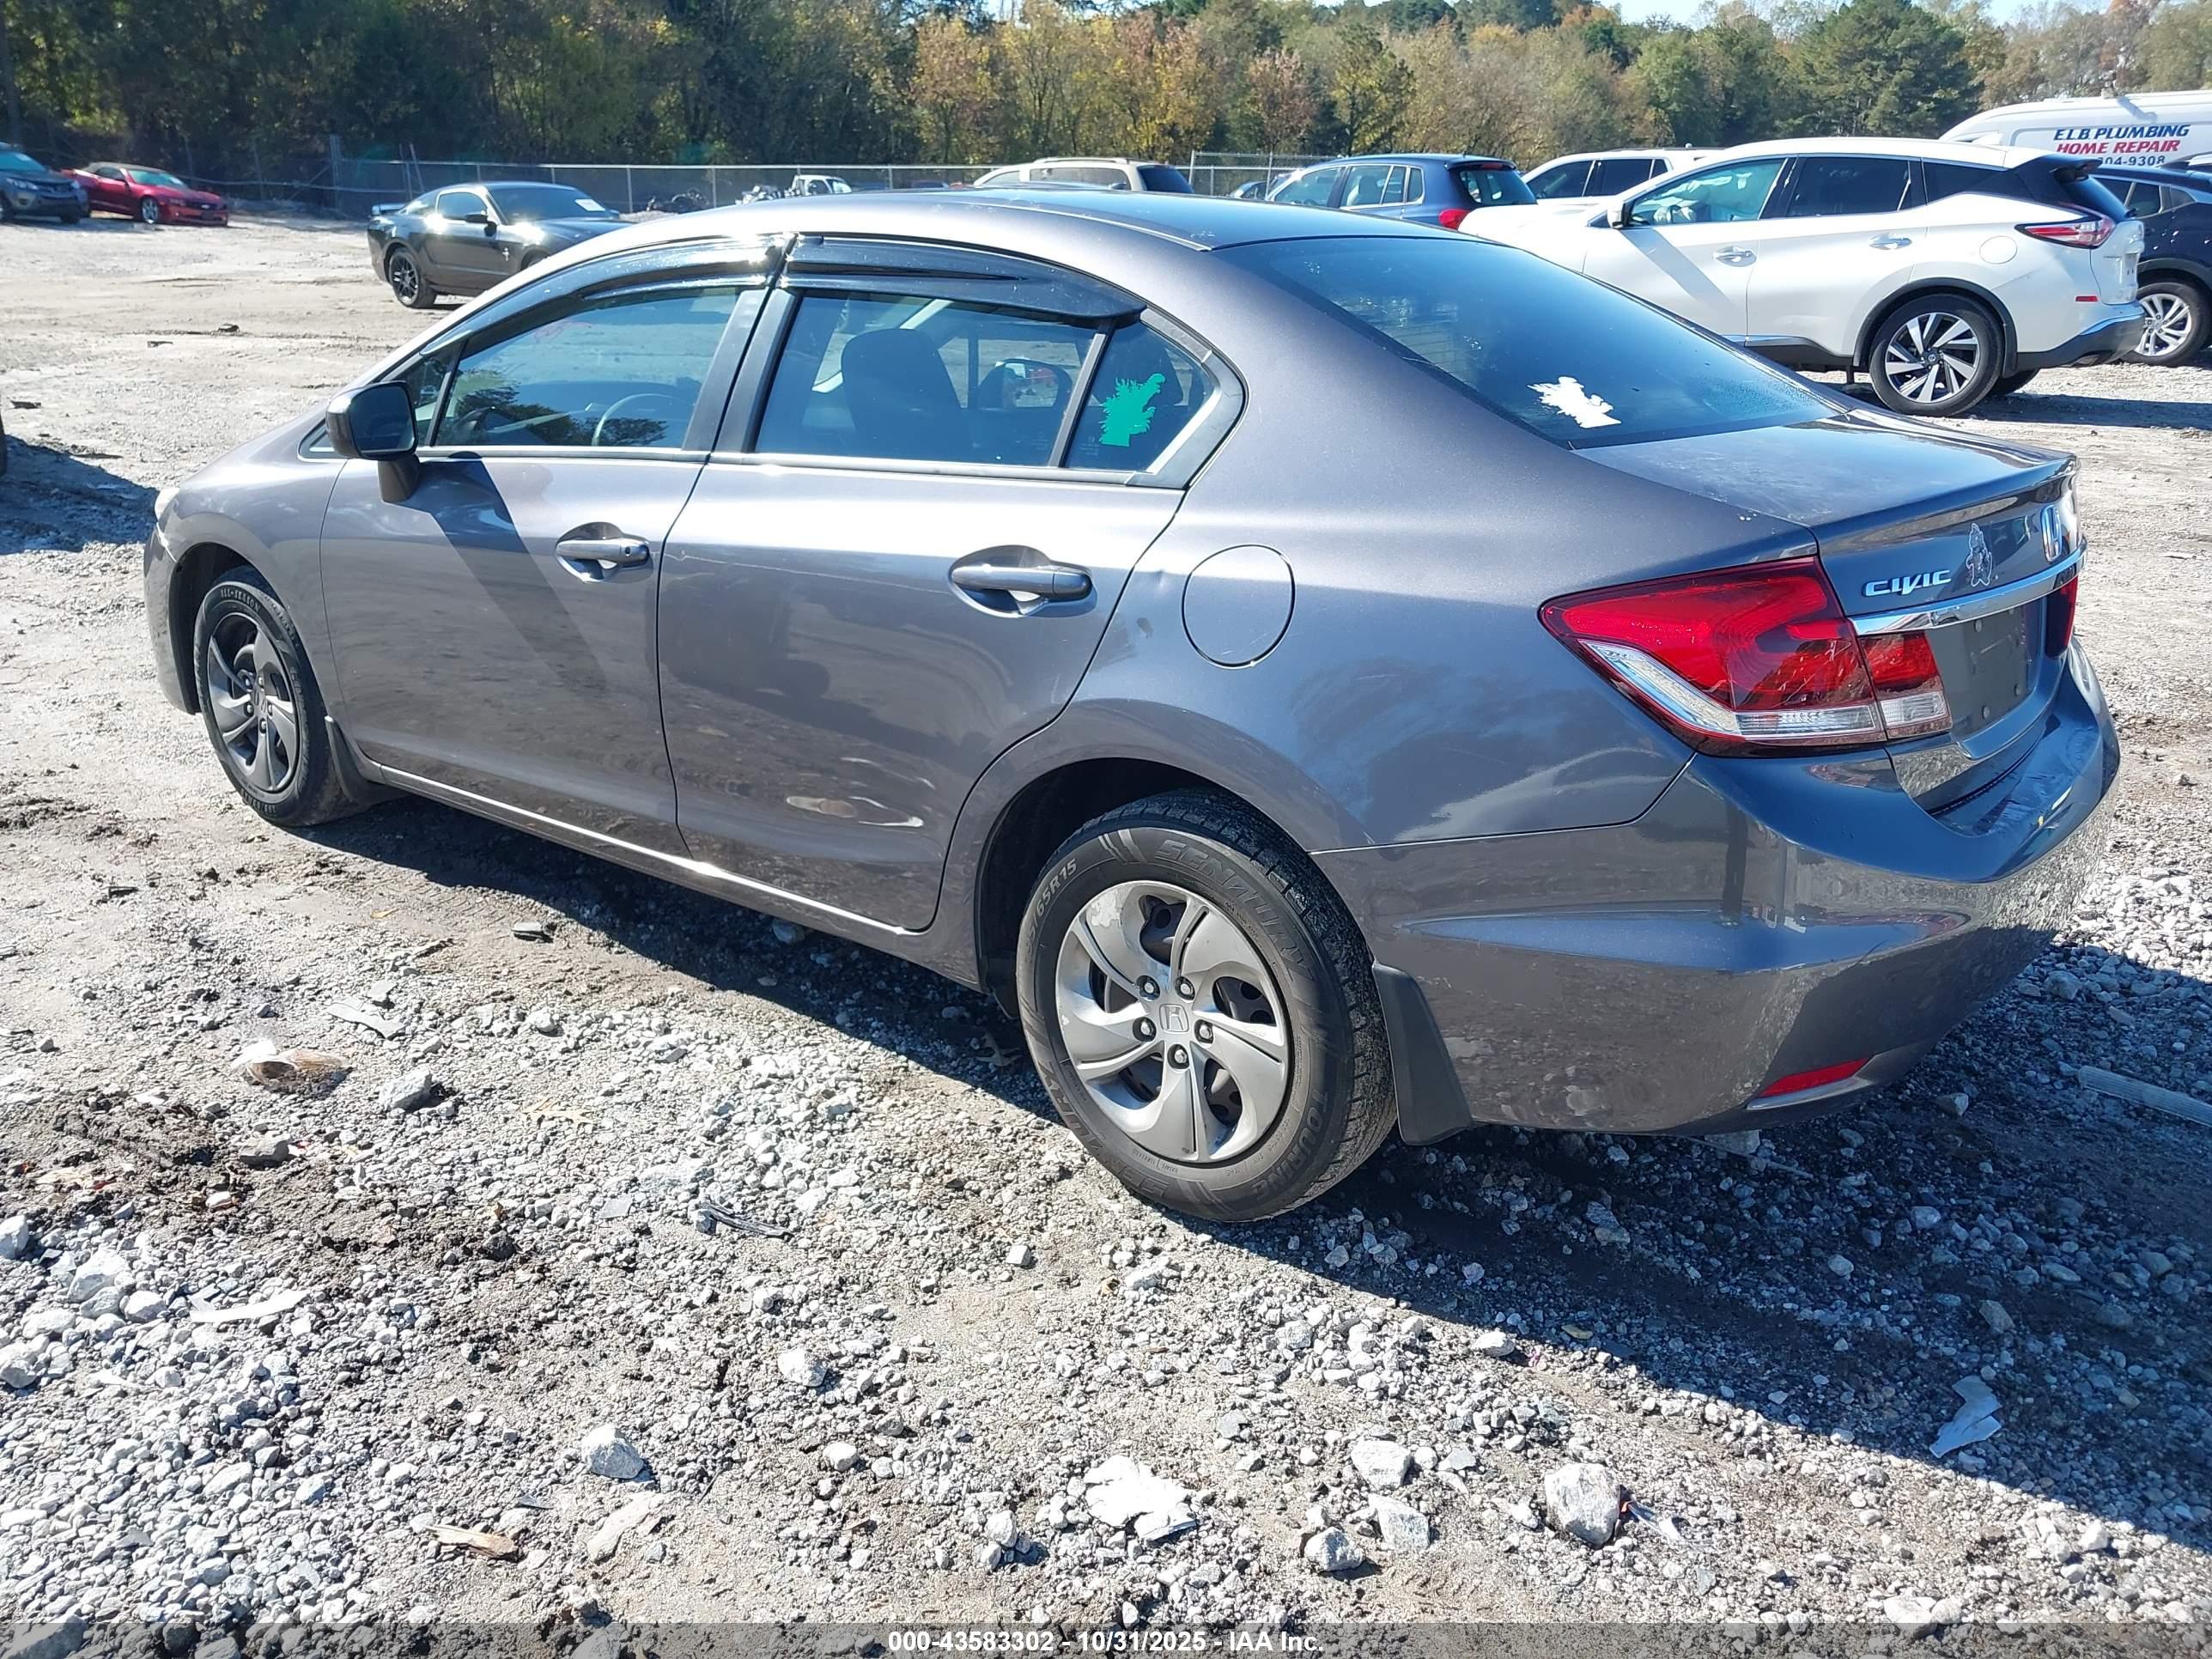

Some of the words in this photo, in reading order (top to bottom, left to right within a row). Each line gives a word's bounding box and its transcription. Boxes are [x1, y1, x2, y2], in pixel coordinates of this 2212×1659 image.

[2093, 125, 2191, 139] PLUMBING
[2057, 142, 2110, 155] HOME
[2112, 140, 2181, 154] REPAIR
[1863, 569, 1952, 597] CIVIC
